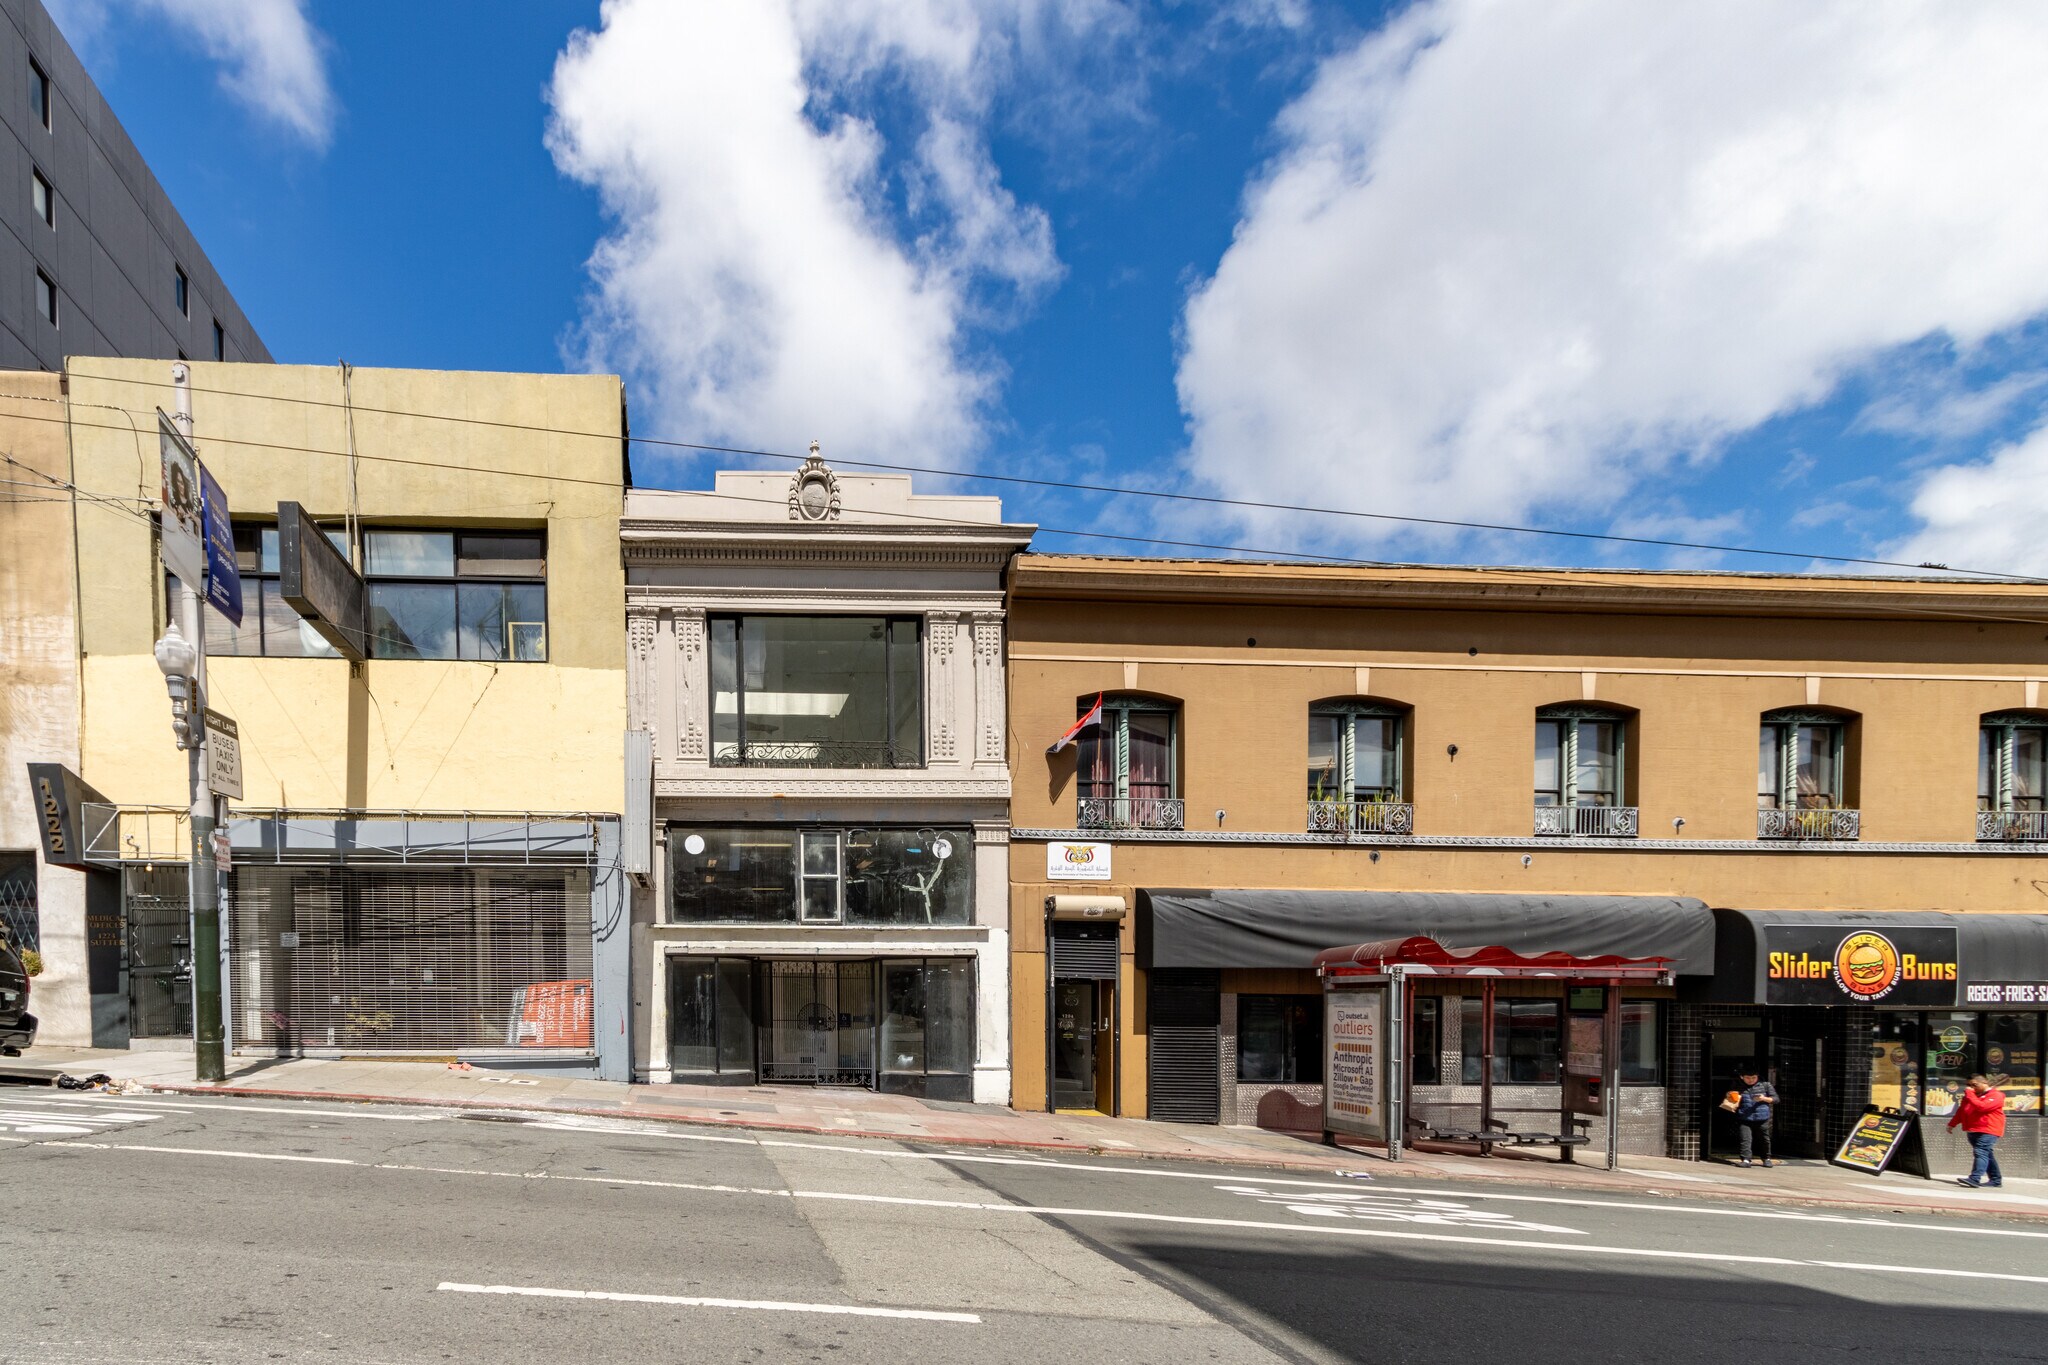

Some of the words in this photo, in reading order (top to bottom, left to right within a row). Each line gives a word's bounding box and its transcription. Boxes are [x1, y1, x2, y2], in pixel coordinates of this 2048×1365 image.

[205, 713, 221, 728] RIGHT
[222, 721, 237, 735] LANE
[212, 733, 235, 751] BUSES
[215, 746, 234, 764] TAXIS
[216, 760, 234, 776] ONLY
[39, 776, 66, 855] 1222
[87, 914, 125, 922] MEDICAL
[90, 921, 125, 929] OFFICES
[1845, 936, 1889, 951] SLIDER
[1769, 951, 1833, 979] Slider
[1902, 953, 1957, 980] Buns
[1833, 966, 1849, 994] FOLLOW
[1850, 991, 1870, 1001] YOUR
[1870, 985, 1893, 1000] TASTE
[1890, 966, 1902, 986] BUDS
[1850, 981, 1884, 992] BUNS
[1345, 1012, 1369, 1020] outset.ai
[1333, 1020, 1373, 1036] outliers
[1333, 1051, 1373, 1066] Anthropic
[1936, 1054, 1964, 1066] OPEN
[1333, 1063, 1364, 1075] Microsoft
[1365, 1066, 1374, 1076] AI
[1333, 1072, 1354, 1083] Zillow
[1359, 1075, 1374, 1087] Gap
[1333, 1081, 1349, 1091] Google
[1350, 1083, 1374, 1094] DeepMind
[1346, 1090, 1374, 1101] Superhuman
